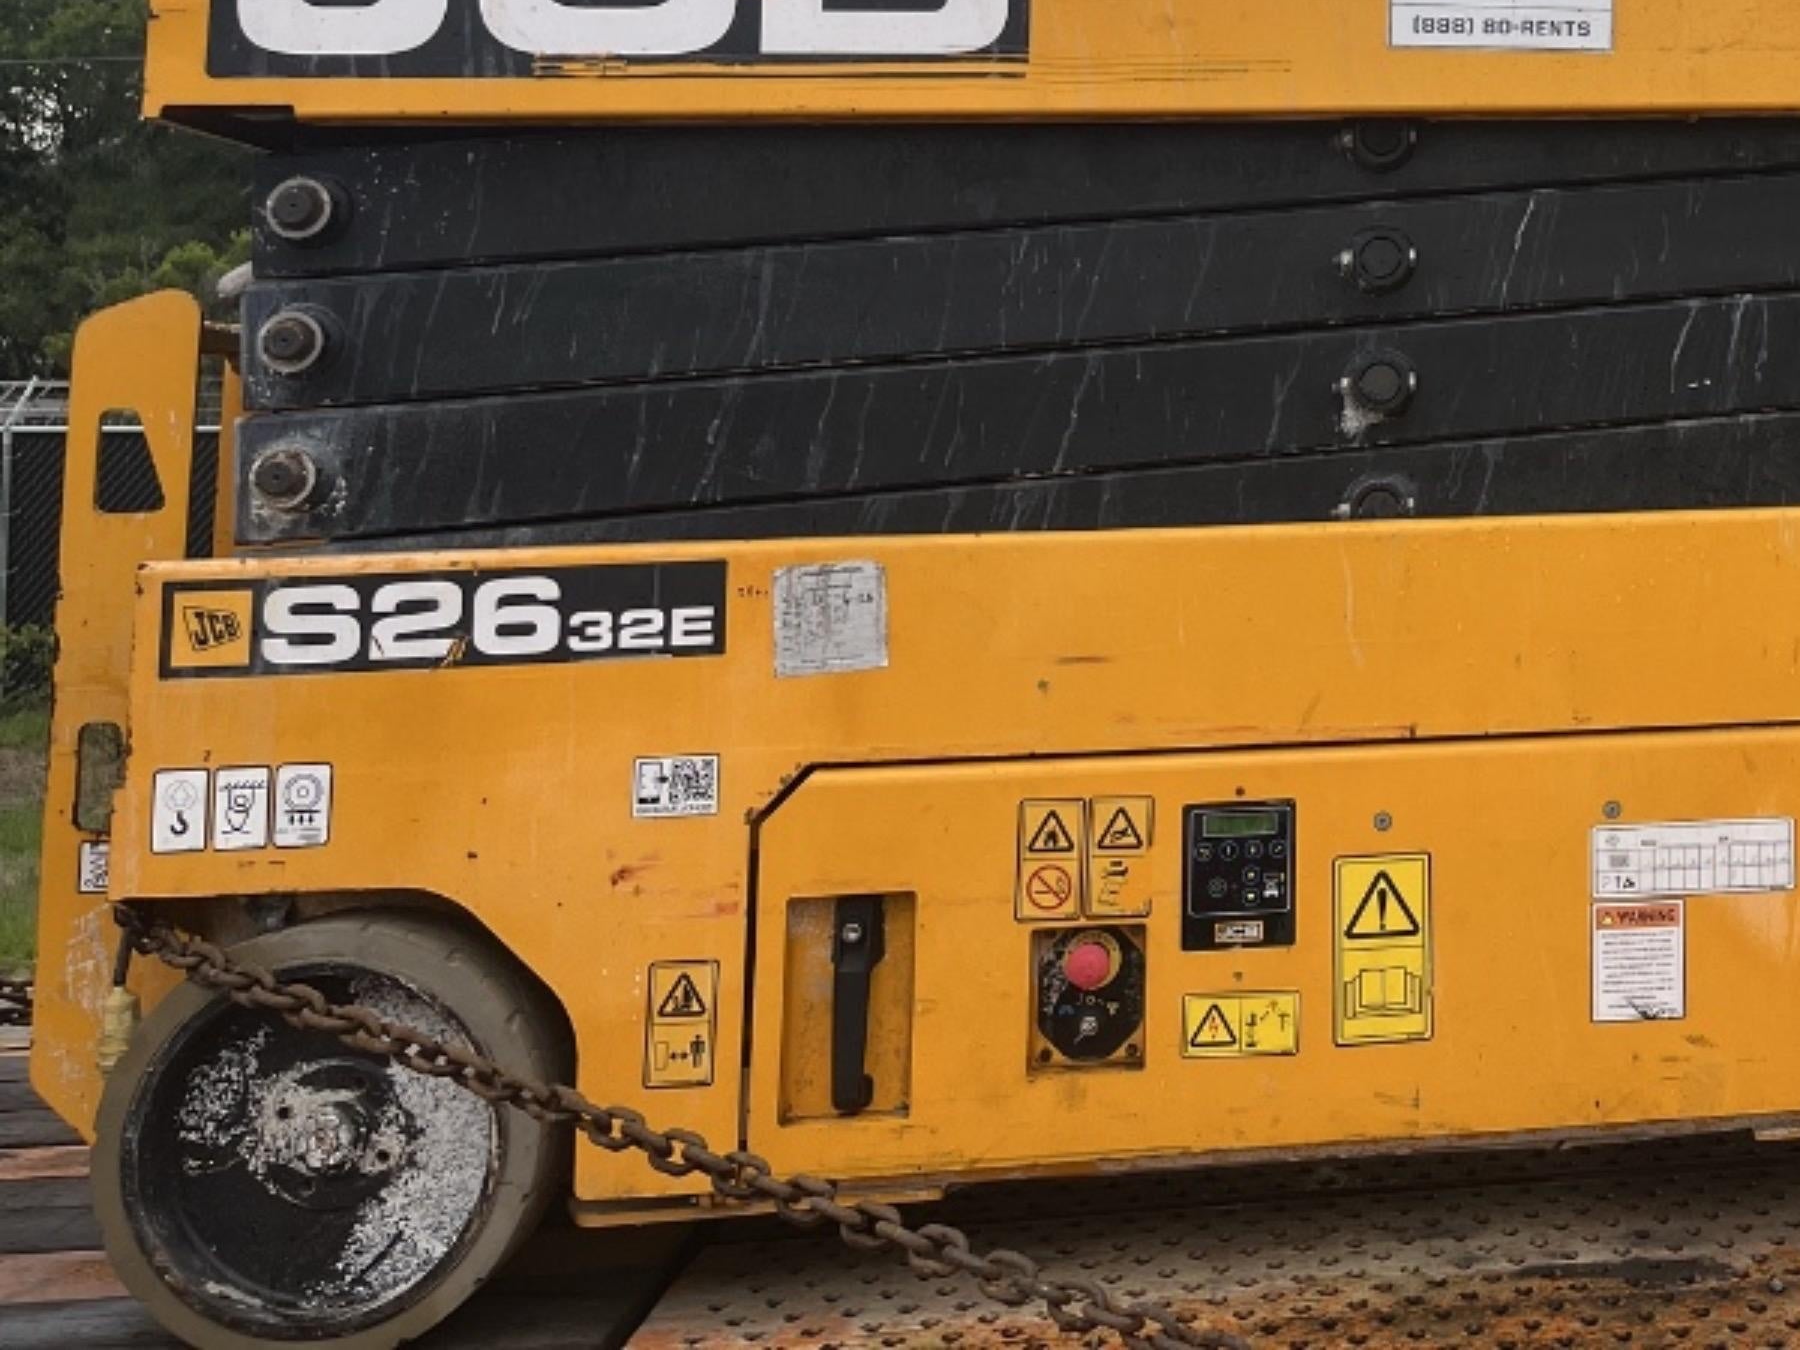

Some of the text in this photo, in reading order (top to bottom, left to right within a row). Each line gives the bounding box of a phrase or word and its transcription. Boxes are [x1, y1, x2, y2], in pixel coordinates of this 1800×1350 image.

[1412, 14, 1592, 38] (888) 80-RENTS
[193, 611, 240, 645] JCB
